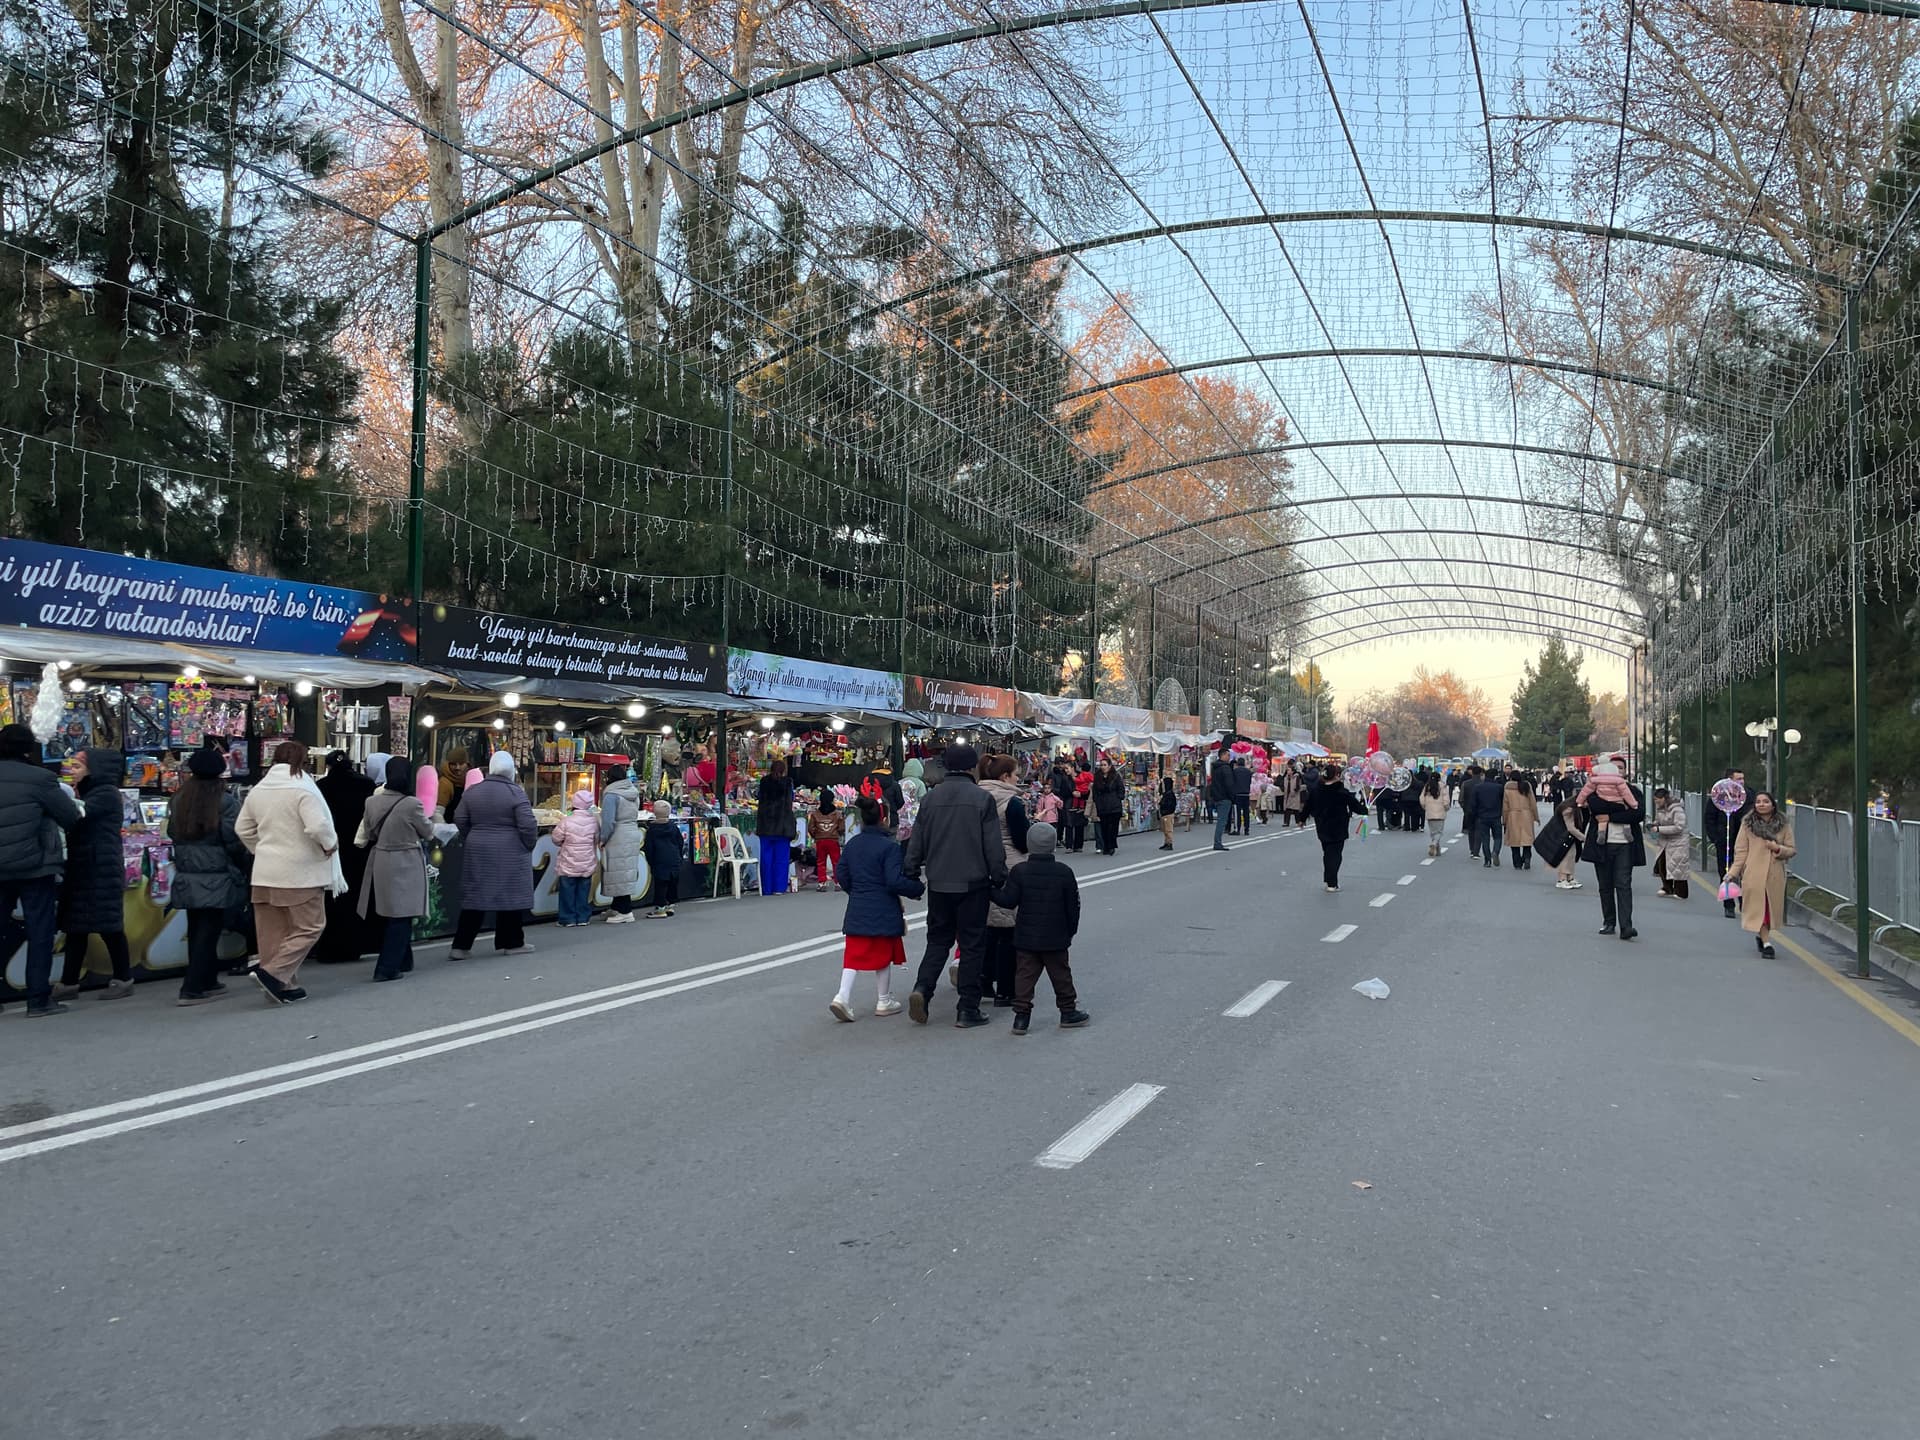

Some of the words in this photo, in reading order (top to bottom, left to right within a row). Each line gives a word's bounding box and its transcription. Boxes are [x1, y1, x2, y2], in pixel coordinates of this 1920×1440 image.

[21, 558, 62, 598] yil
[65, 561, 178, 607] bayrami
[179, 583, 281, 616] muborak
[39, 601, 100, 628] aziz
[105, 605, 264, 645] vatandoshlar!
[480, 615, 527, 647] Yangi
[527, 627, 546, 649] yil
[545, 629, 616, 657] barchamizga
[447, 640, 523, 666] baxt-saodat,
[526, 651, 564, 676] oilaviy
[607, 661, 661, 680] qut-baraka
[662, 666, 679, 681] olib
[680, 667, 709, 684] kelsin!
[734, 656, 767, 690] Yangi
[768, 667, 781, 691] yil
[782, 668, 805, 688] ulkan
[925, 681, 953, 712] Yangi
[953, 689, 980, 714] yilingiz
[980, 691, 999, 710] bilan!
